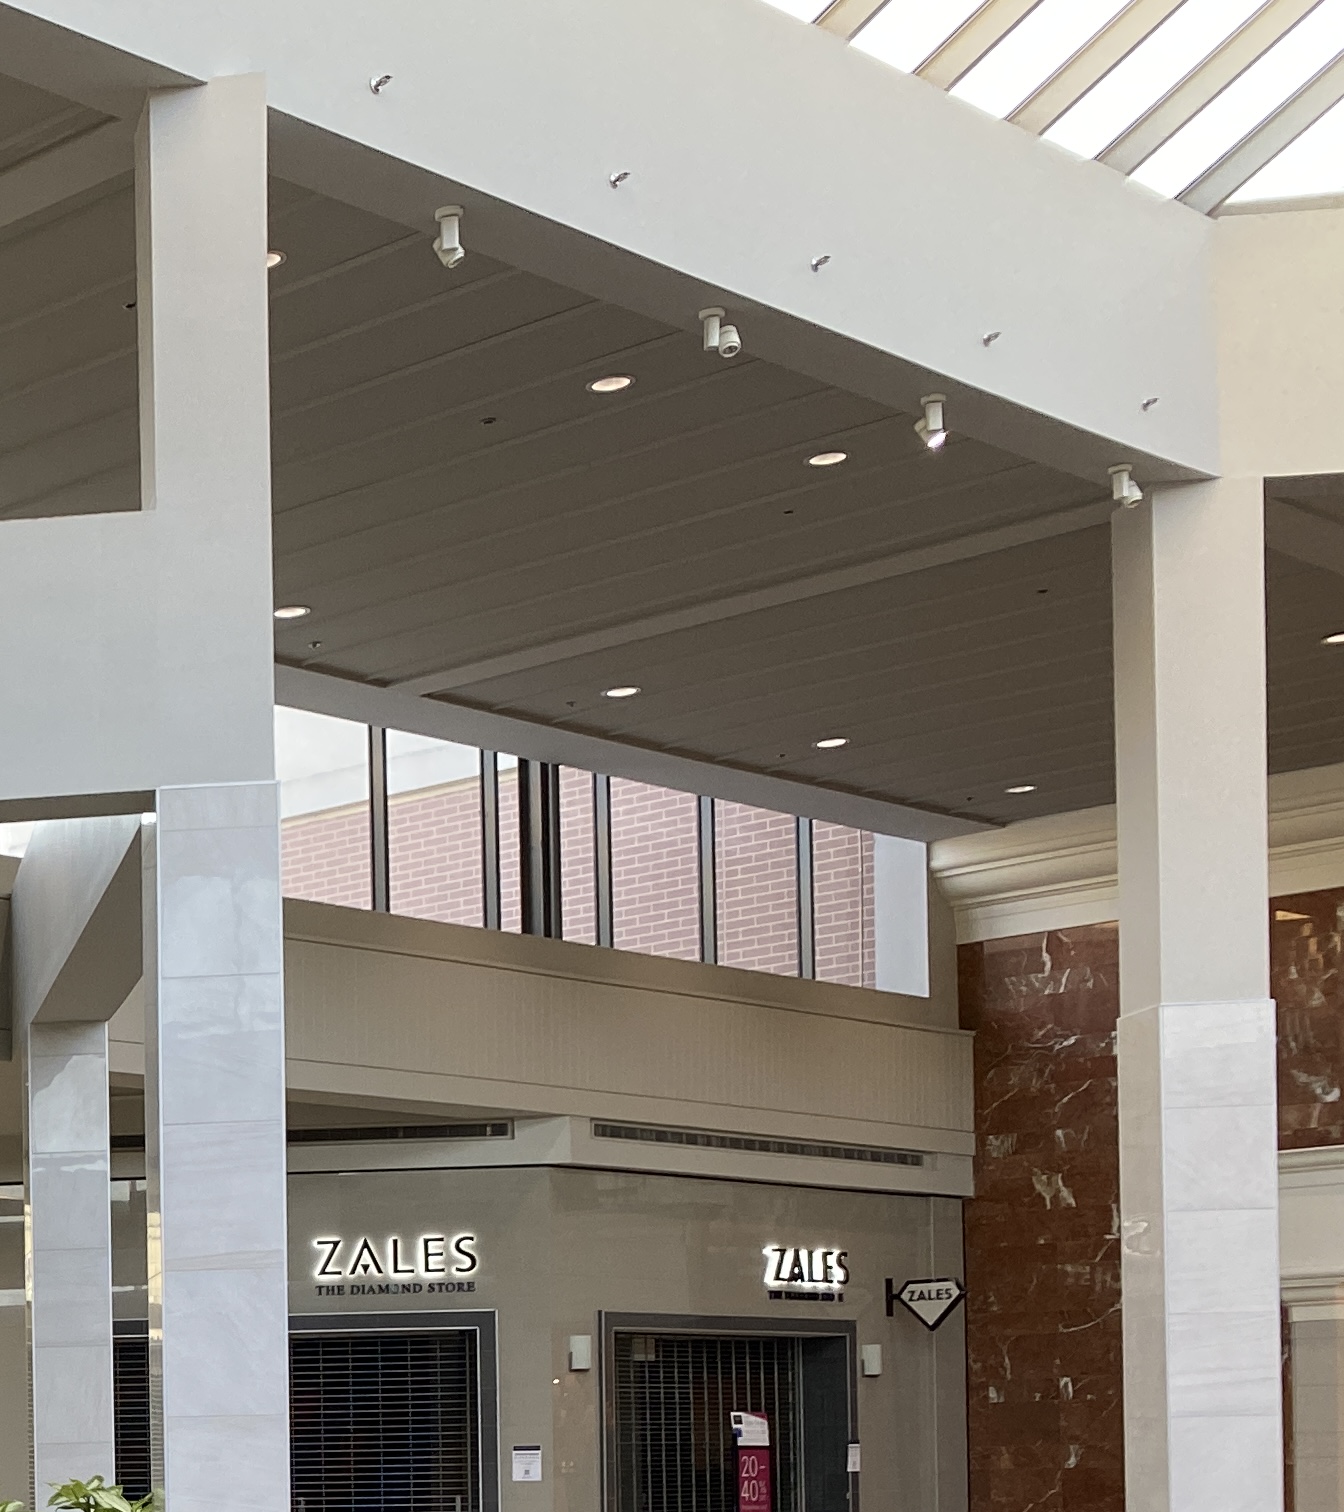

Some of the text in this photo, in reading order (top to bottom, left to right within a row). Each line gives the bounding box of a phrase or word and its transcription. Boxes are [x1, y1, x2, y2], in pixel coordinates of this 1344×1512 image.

[316, 1236, 478, 1276] ZALES
[771, 1247, 850, 1285] ZALES
[315, 1281, 476, 1296] THE DIAMOND STORE
[907, 1287, 953, 1303] ZALES
